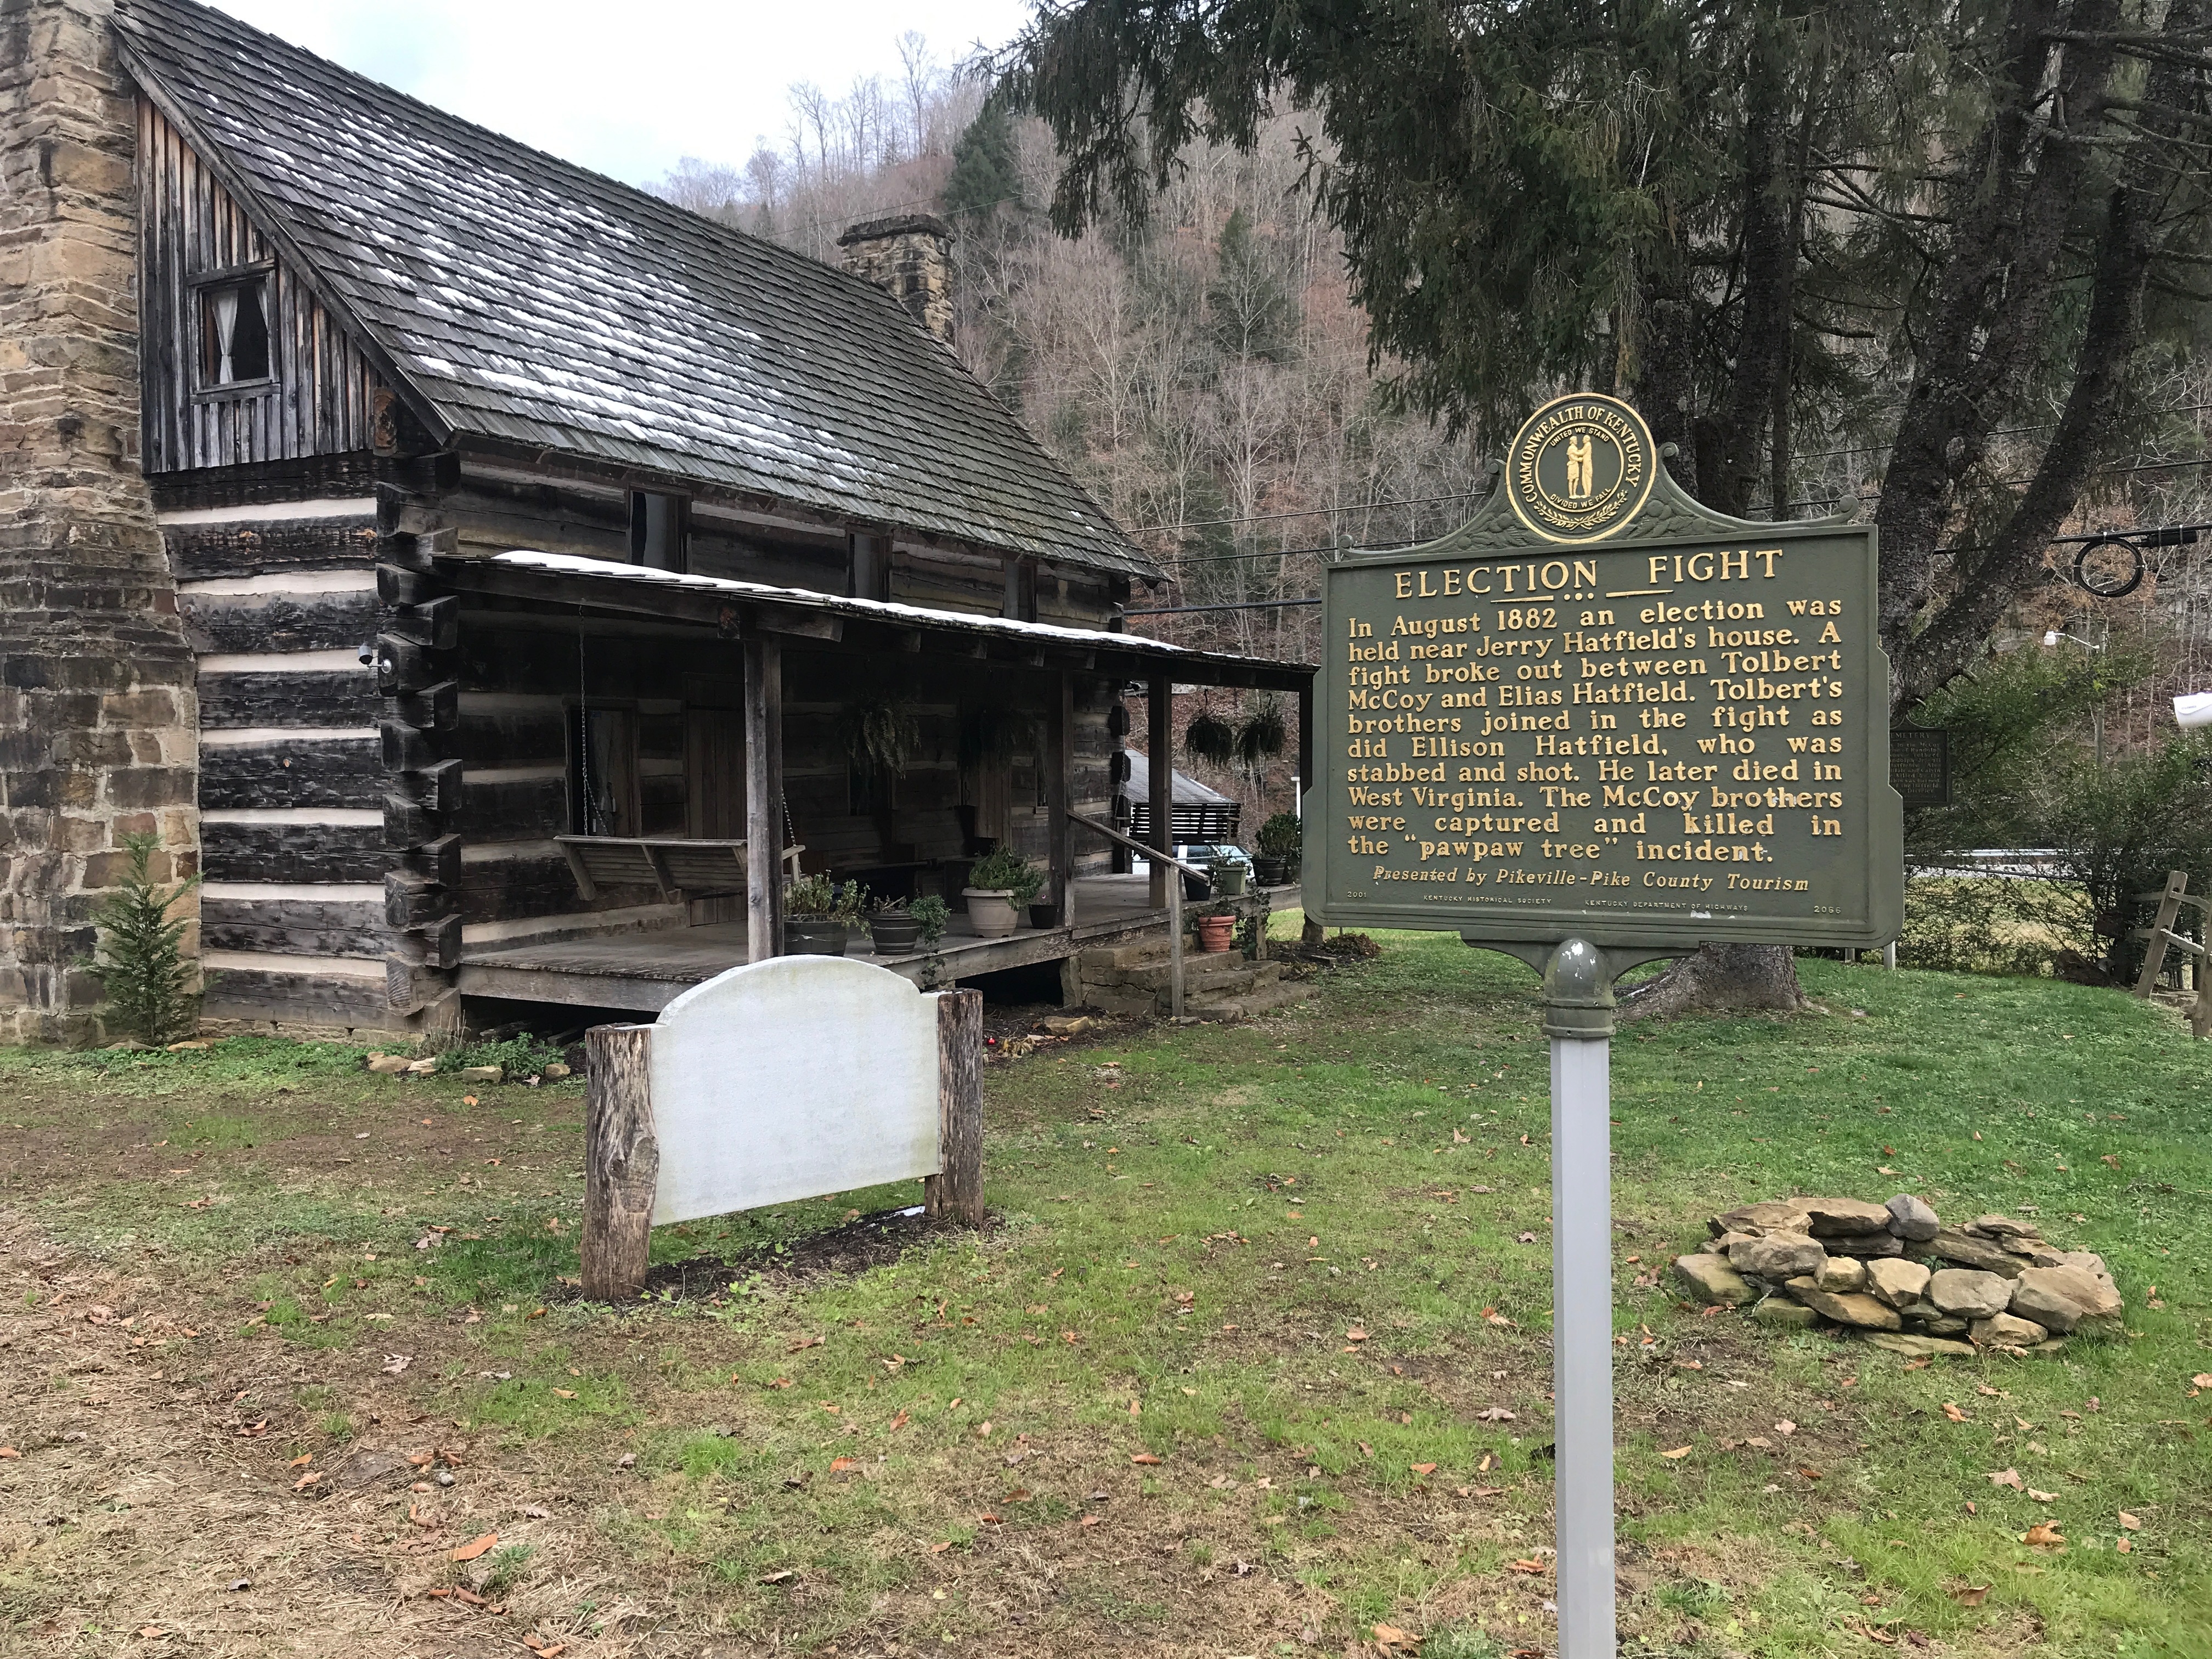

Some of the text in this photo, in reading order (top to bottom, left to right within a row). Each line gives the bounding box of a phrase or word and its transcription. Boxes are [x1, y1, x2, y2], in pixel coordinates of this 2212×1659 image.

[1550, 429, 1572, 447] UNITED
[1588, 427, 1610, 443] STAND
[1519, 405, 1642, 503] COMMONWEALTH OF KENTUCKY
[1550, 494, 1578, 509] DIVIDED
[1595, 488, 1611, 503] FALL
[1395, 549, 1784, 600] ELECTION FIGHT
[1348, 599, 1842, 640] In August 1882 an election was
[1348, 620, 1842, 662] held near Jerry Hatfield's house. A
[1348, 648, 1842, 691] fight broke out between Tolbert
[1347, 675, 1843, 713] McCoy and Elias Hatfield. Tolbert's
[1347, 704, 1843, 737] brothers joined in the fight as
[1347, 732, 1843, 758] did Ellison Hatfield, who was
[1347, 758, 1843, 783] stabbed and shot. He later died in
[1347, 784, 1843, 813] West Virginia. The McCoy brothers
[1347, 811, 1842, 837] were captured and killed in
[1347, 834, 1389, 855] the
[1635, 838, 1774, 863] incident.
[1372, 865, 1459, 882] Presented
[1465, 867, 1488, 887] by
[1643, 871, 1714, 892] County
[1727, 872, 1809, 891] Tourism
[1814, 905, 1841, 914] 2066
